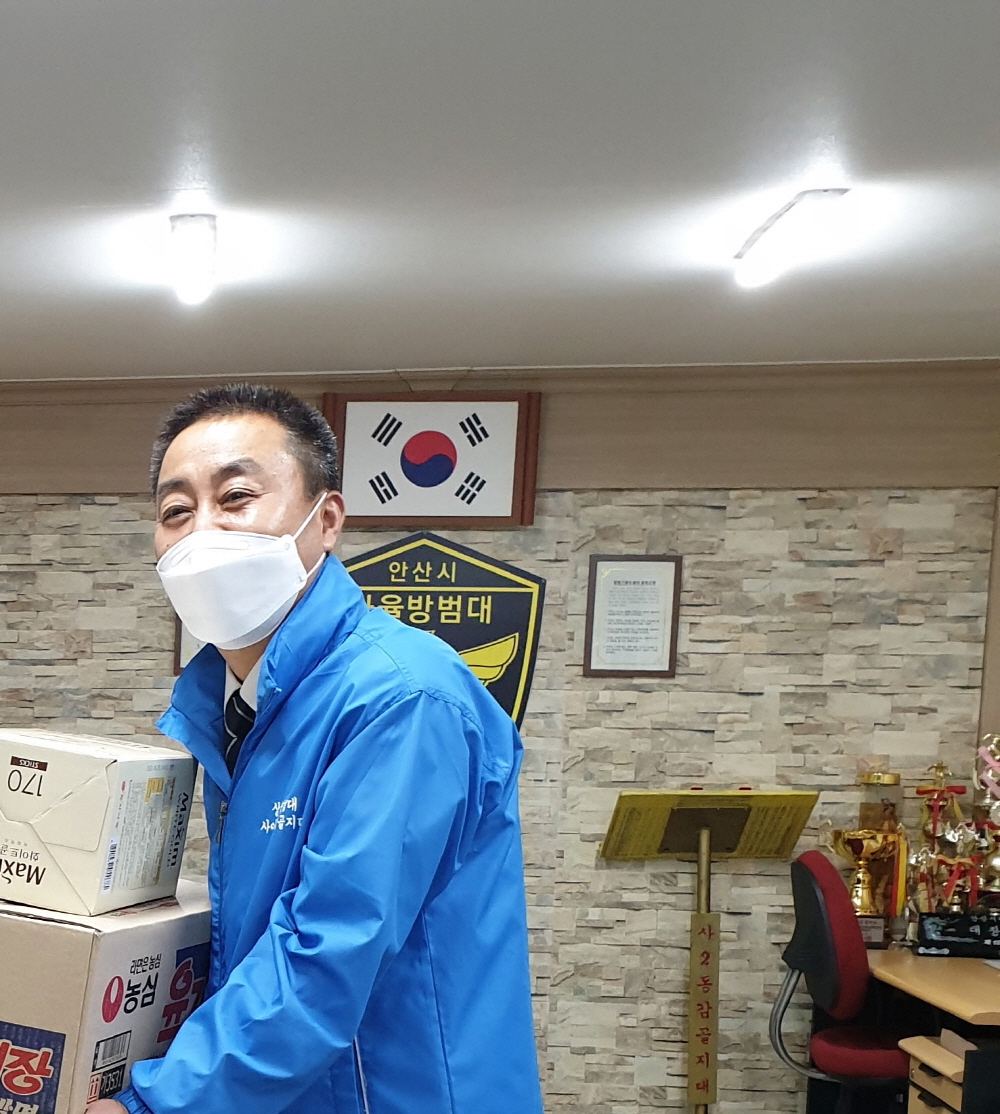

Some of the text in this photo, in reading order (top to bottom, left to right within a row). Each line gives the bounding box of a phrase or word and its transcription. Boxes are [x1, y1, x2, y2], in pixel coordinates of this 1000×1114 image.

[388, 561, 457, 583] 안산시
[7, 769, 43, 797] 170
[123, 972, 159, 1014] 농심
